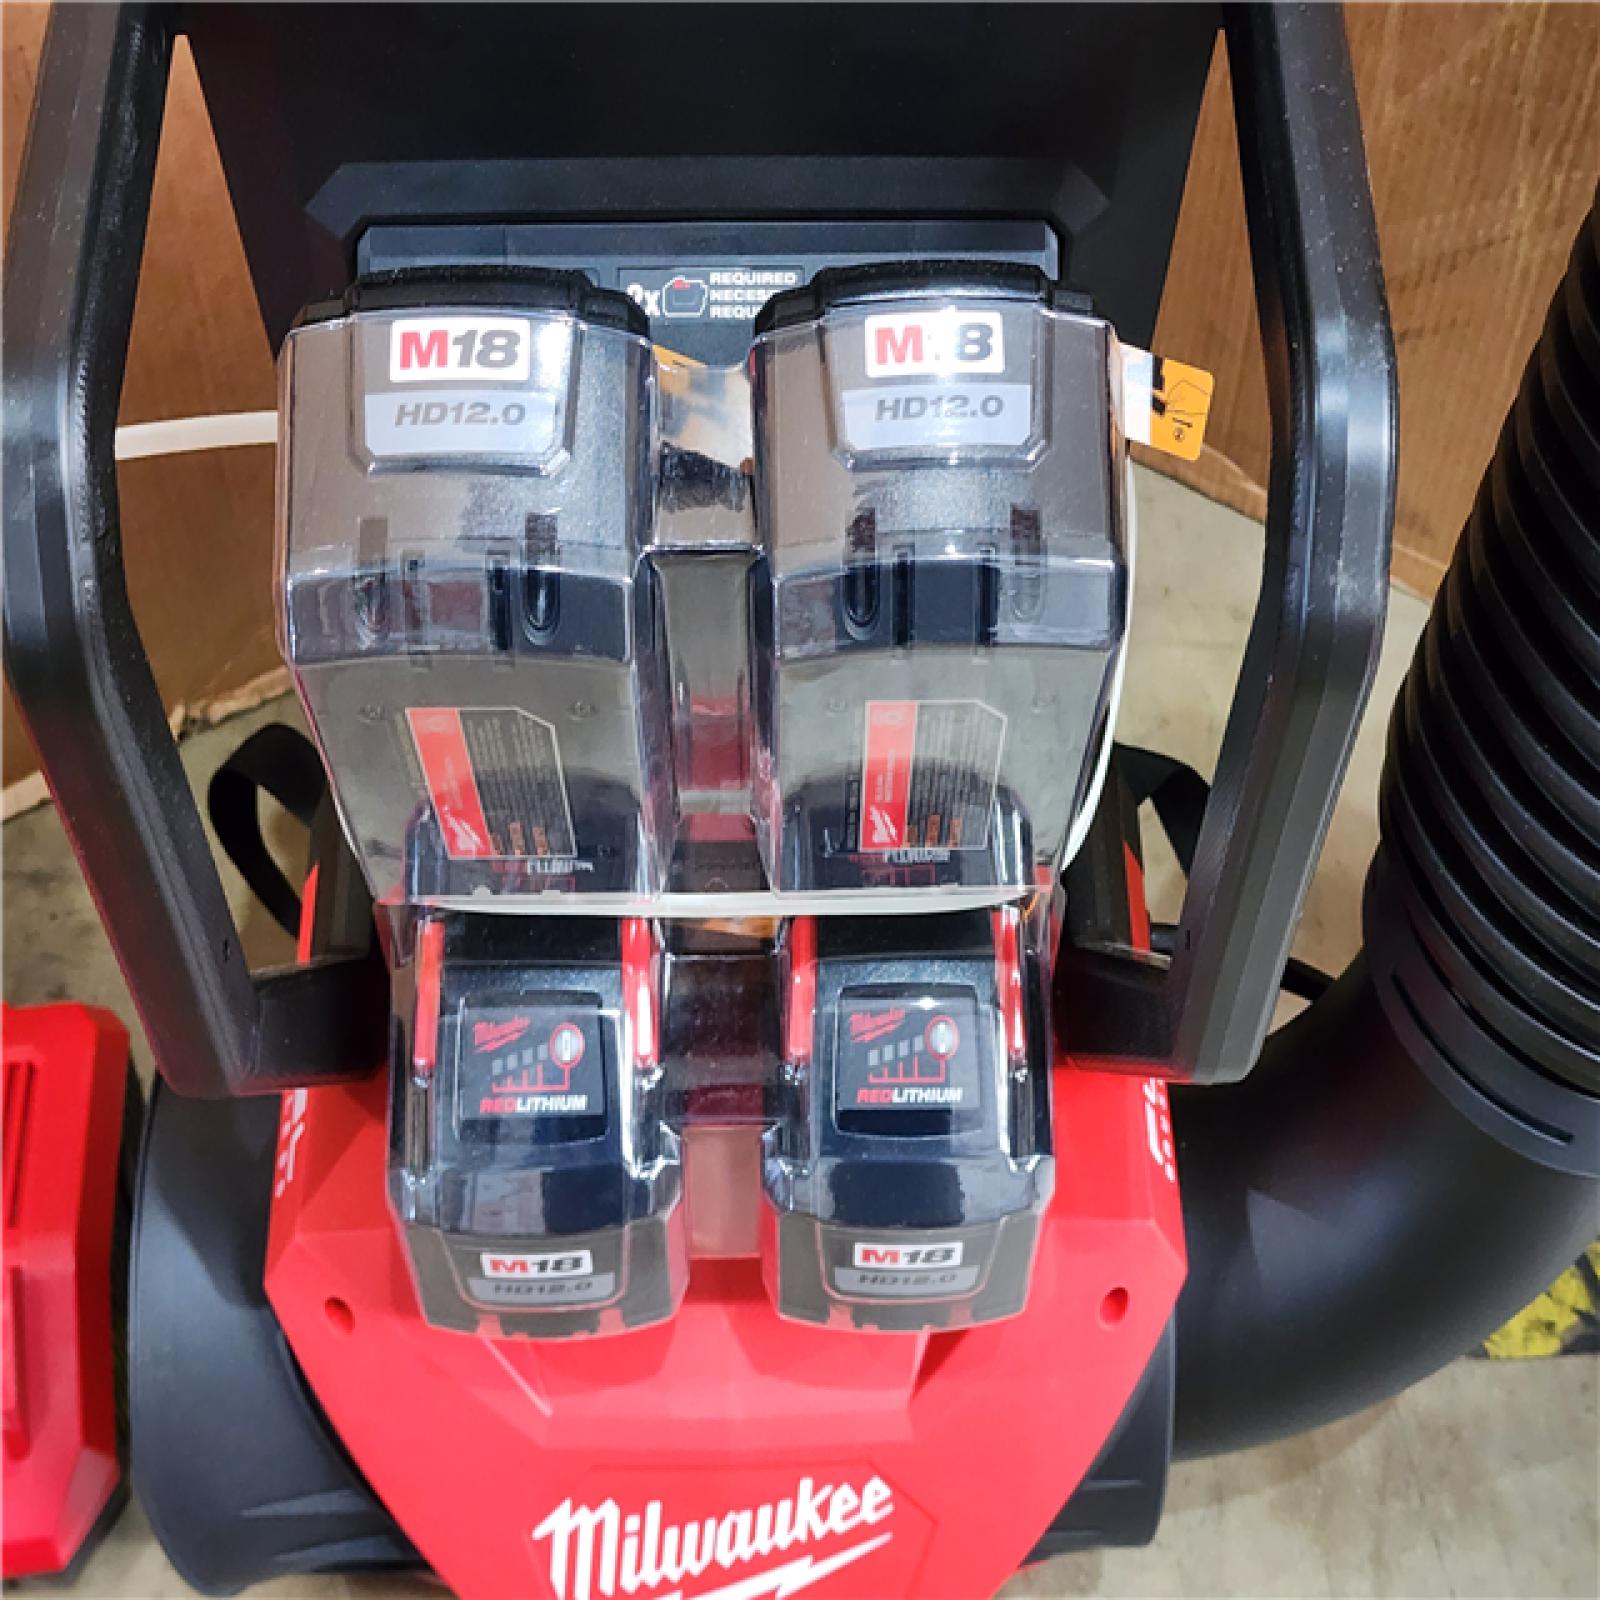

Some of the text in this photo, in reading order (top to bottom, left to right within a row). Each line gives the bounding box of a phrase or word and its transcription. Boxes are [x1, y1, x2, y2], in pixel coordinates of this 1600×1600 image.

[709, 271, 797, 286] REQUIRED
[399, 329, 522, 370] M18
[874, 323, 995, 366] M8
[394, 401, 527, 427] HD12.0
[874, 394, 1004, 422] HD12.0
[479, 1094, 589, 1114] REDLITHIUM
[856, 1087, 964, 1104] REDLITHIUM
[489, 1256, 584, 1274] M18
[861, 1246, 957, 1265] M18
[532, 1475, 895, 1600] Milwaukee
